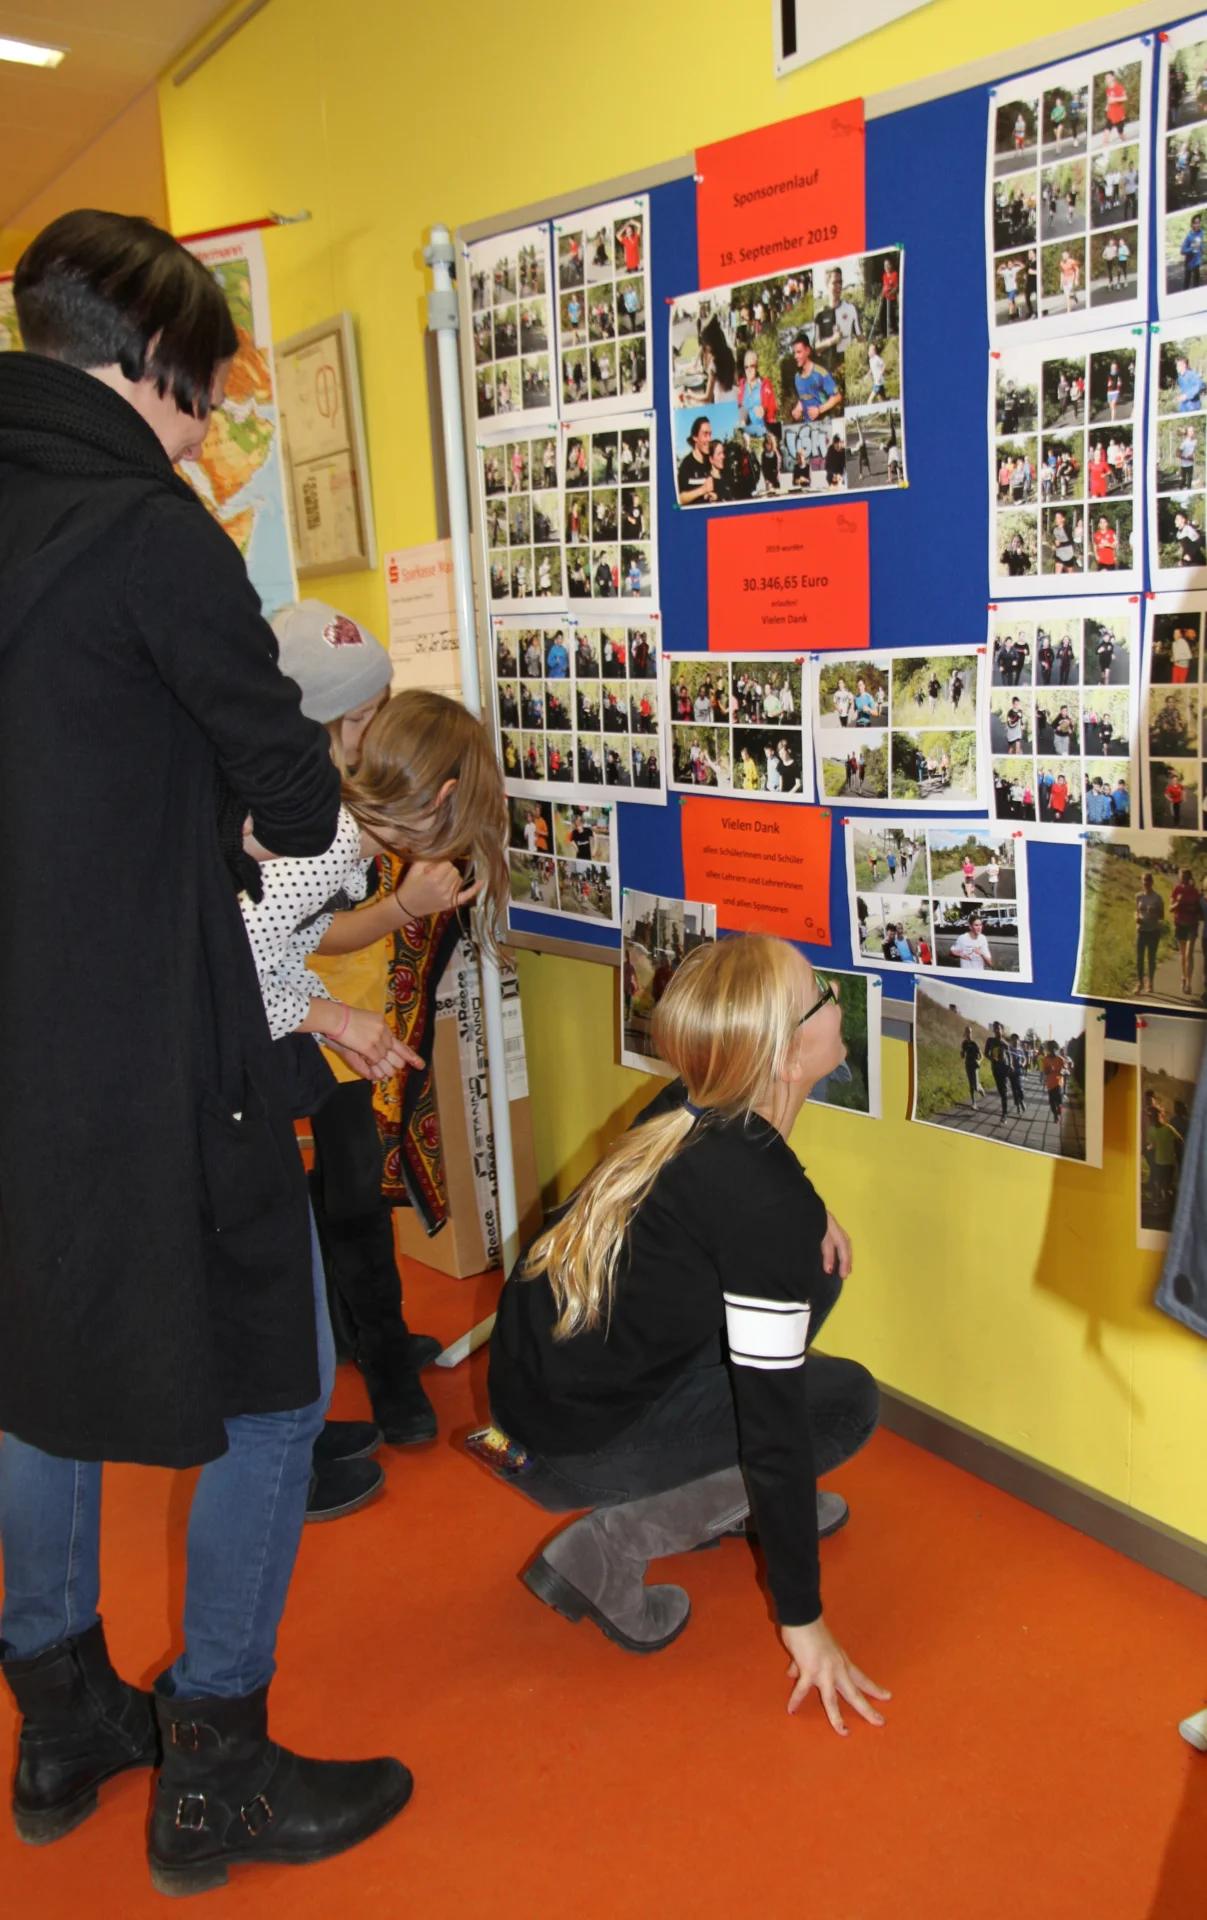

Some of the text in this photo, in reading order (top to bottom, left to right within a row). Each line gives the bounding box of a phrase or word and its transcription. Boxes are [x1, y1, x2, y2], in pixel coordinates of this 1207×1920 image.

[733, 169, 819, 208] Sponsorenlauf
[720, 224, 838, 267] 19. September 2019
[743, 575, 829, 592] 30.346,65 Euro
[761, 613, 808, 625] Vielen Dank
[721, 817, 780, 834] Vielen Dank
[703, 846, 804, 865] allen Schülerinnen und Schüler
[705, 870, 804, 891] allen Lehrern und Lehrerinnen
[722, 897, 788, 915] und allen Sponsoren
[485, 1210, 499, 1258] Reece
